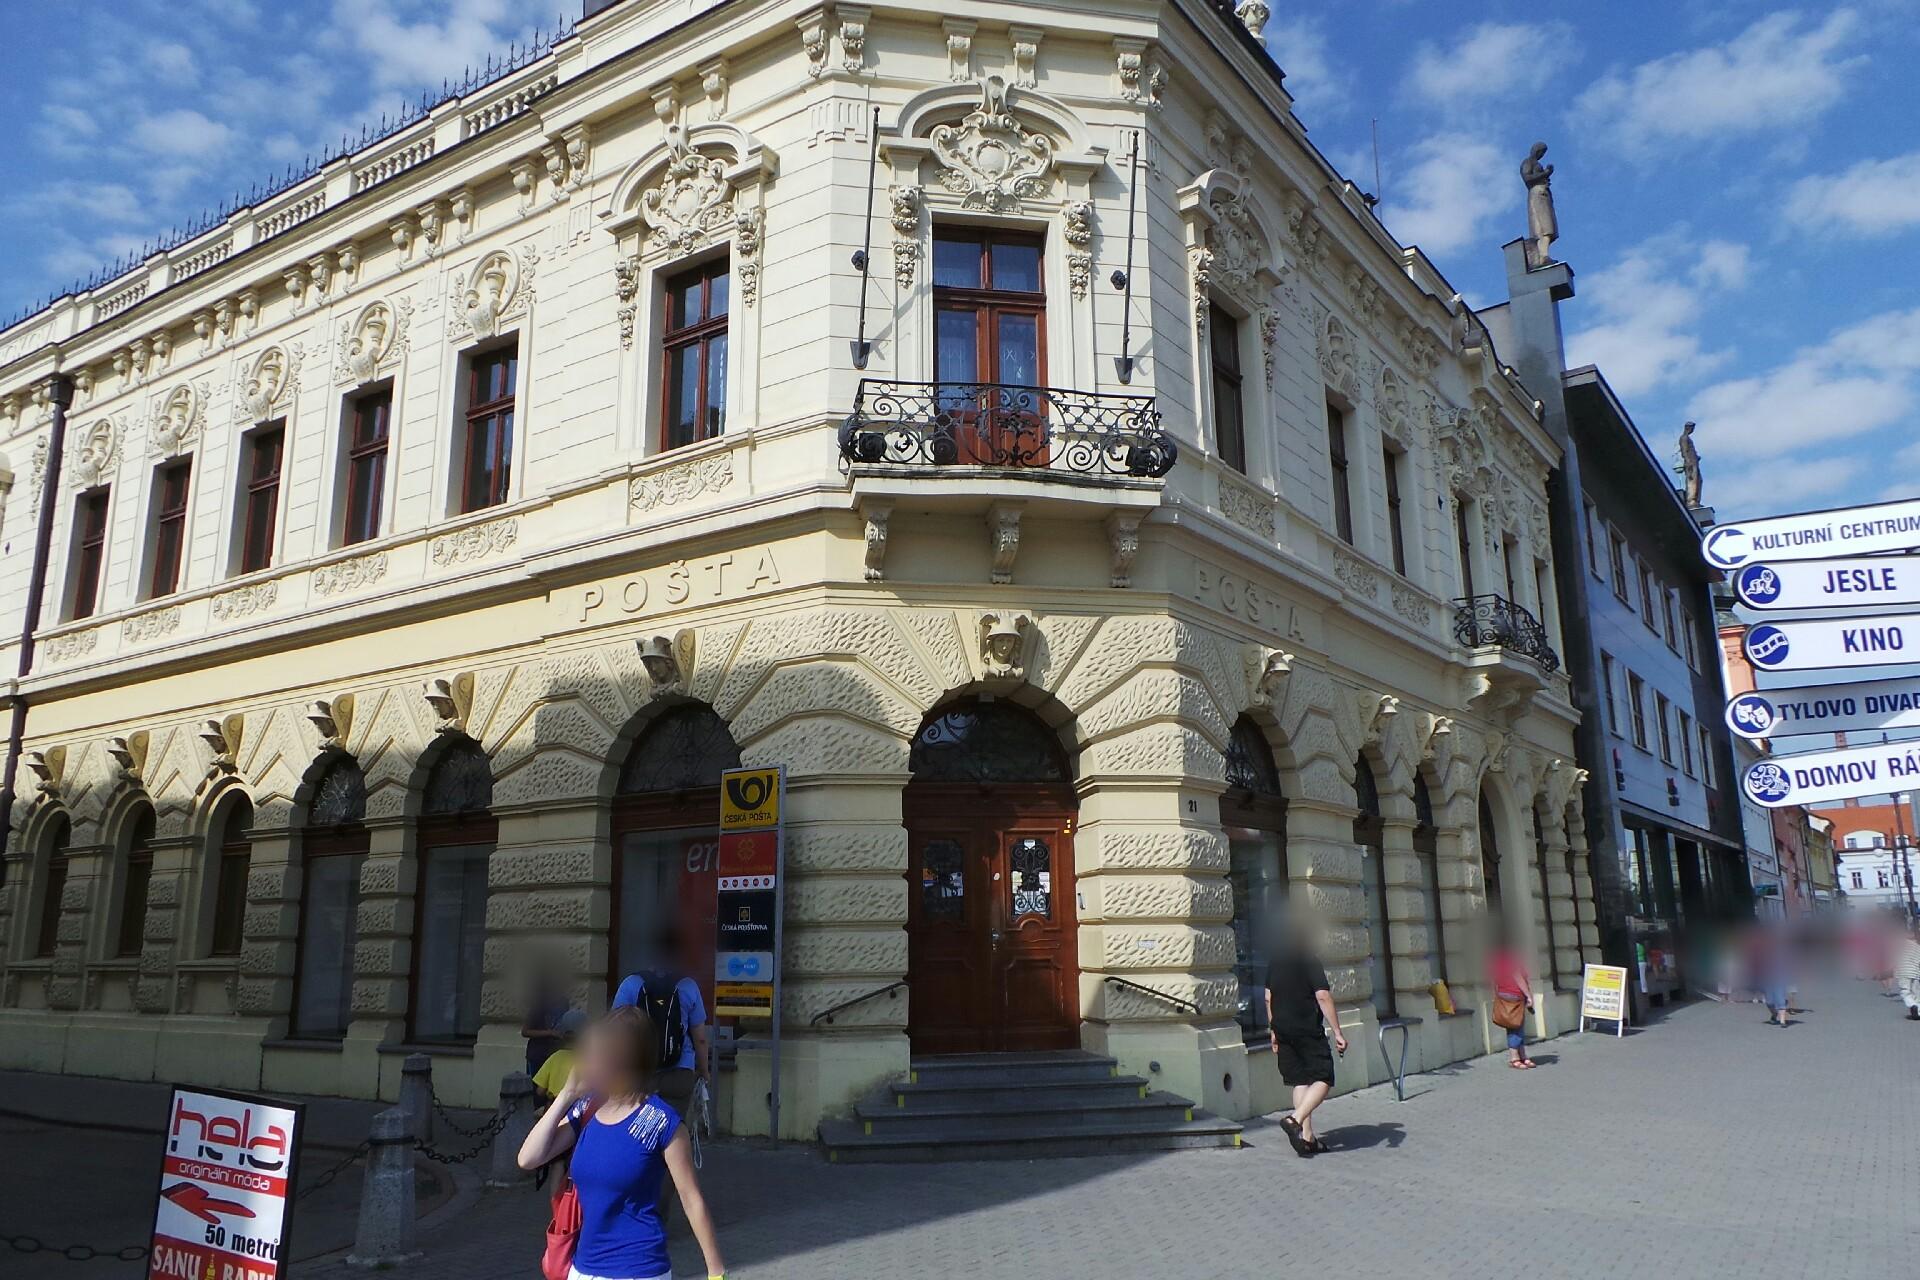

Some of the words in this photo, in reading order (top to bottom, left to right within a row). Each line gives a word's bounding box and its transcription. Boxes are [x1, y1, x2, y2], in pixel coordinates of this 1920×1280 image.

[1752, 522, 1833, 551] KULTURNÍ
[1840, 515, 1920, 540] CENTRUM
[580, 548, 781, 623] POŠTA
[1823, 568, 1898, 594] JESLE
[1193, 559, 1304, 642] POŠTA
[1842, 626, 1904, 653] KINO
[1777, 696, 1856, 722] TYLOVO
[1795, 759, 1876, 790] DOMOV
[1888, 749, 1920, 778] RÁ
[724, 812, 747, 824] ČESKÁ
[749, 810, 772, 821] POŠTA
[1188, 799, 1198, 813] 21
[178, 1162, 232, 1183] originální
[204, 1223, 226, 1248] 50
[231, 1232, 279, 1261] metrů
[152, 1244, 202, 1280] SANU
